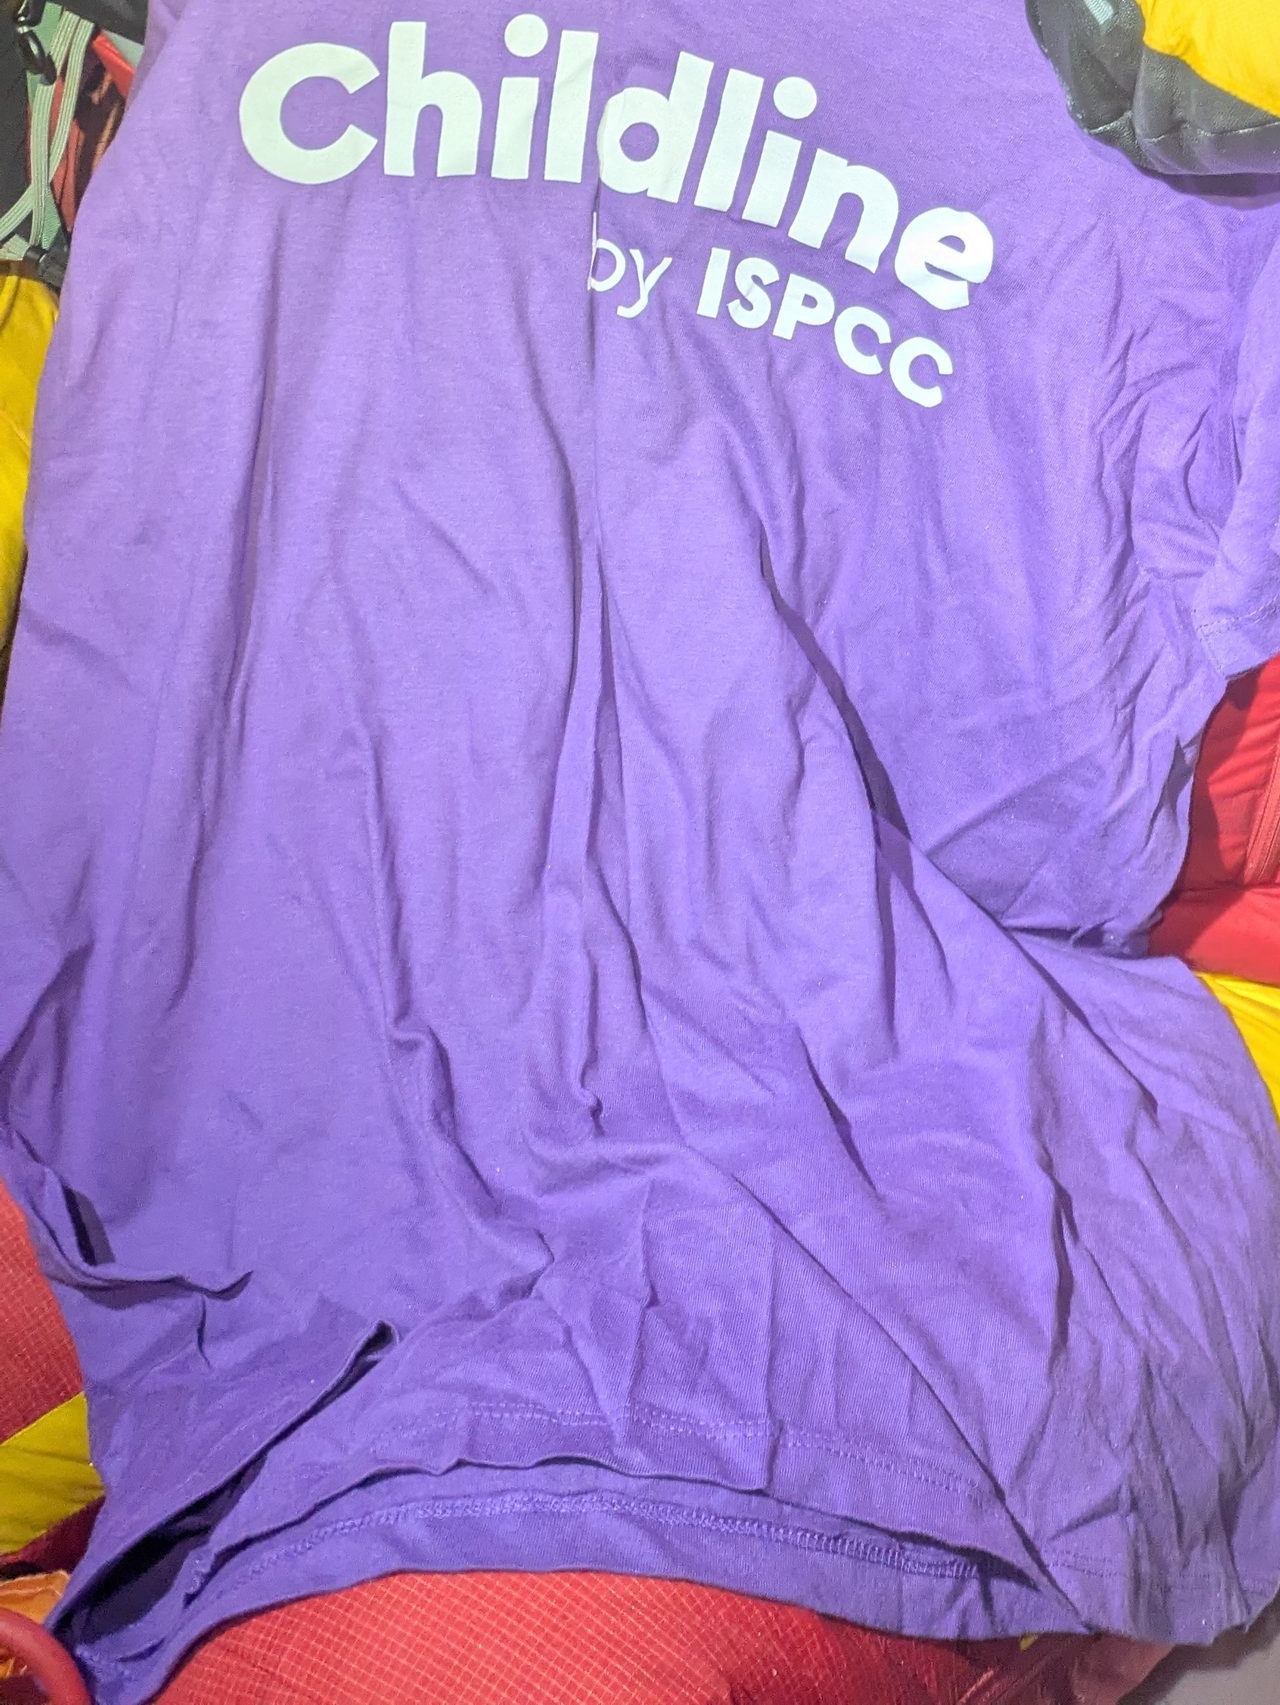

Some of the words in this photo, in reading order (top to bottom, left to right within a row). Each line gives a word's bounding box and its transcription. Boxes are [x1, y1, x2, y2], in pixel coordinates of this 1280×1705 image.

[238, 13, 995, 311] Childline
[587, 211, 673, 318] by
[696, 247, 954, 409] ISPCC
